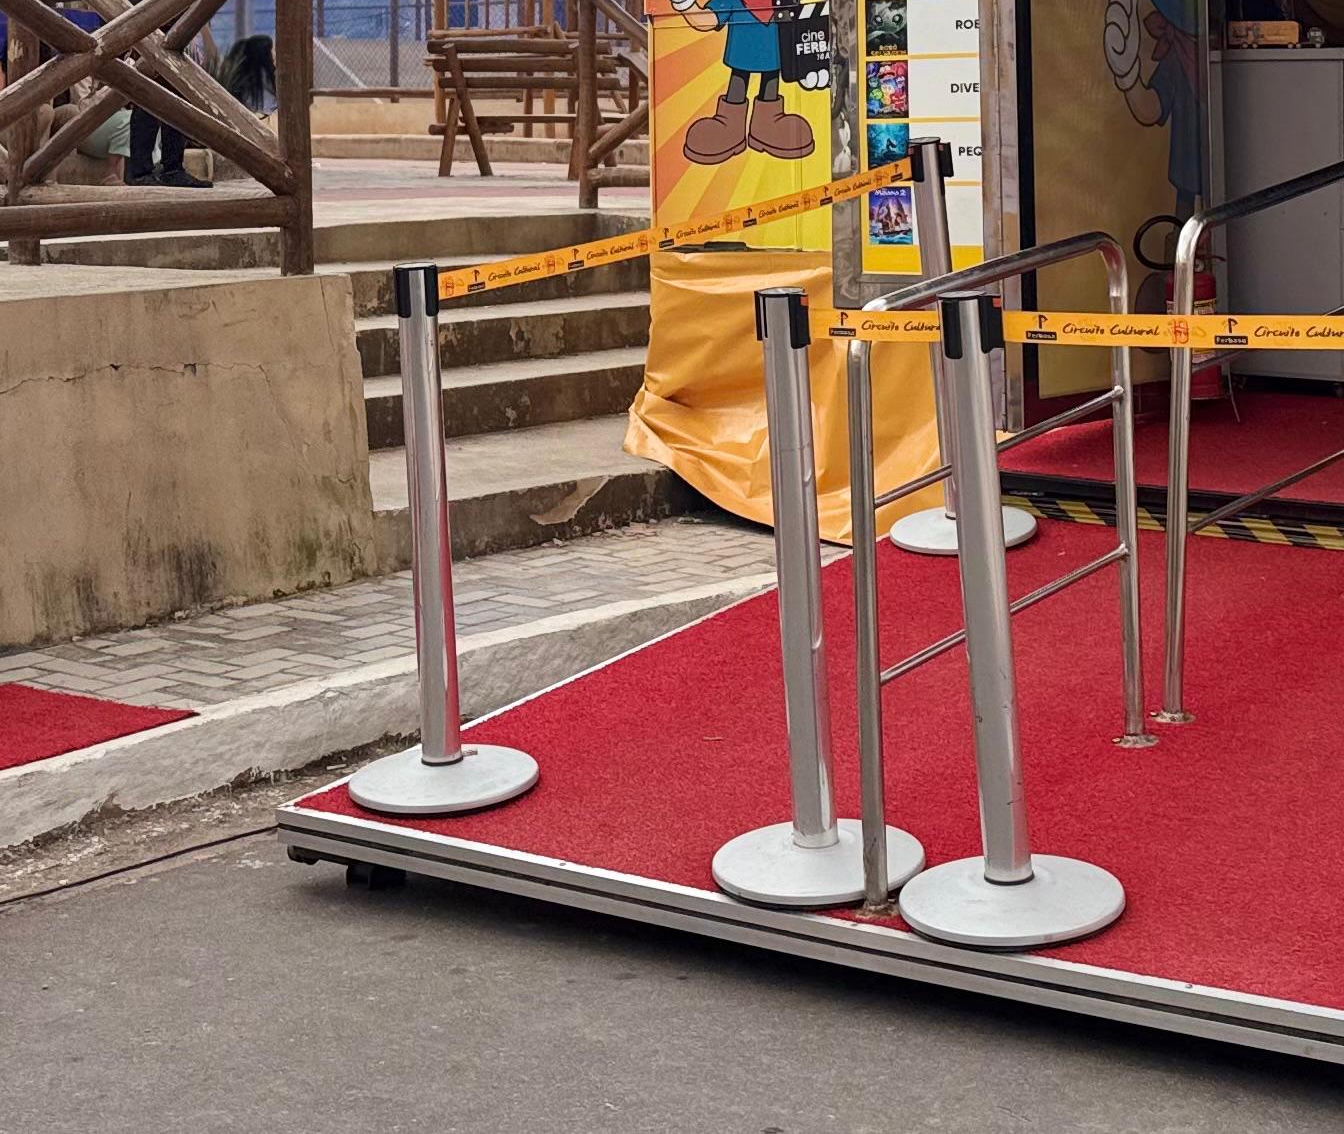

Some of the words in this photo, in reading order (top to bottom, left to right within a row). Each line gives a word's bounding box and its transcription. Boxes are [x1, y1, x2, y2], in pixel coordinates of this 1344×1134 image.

[801, 30, 825, 43] cine
[950, 82, 980, 94] DIVE
[861, 319, 899, 331] Circuito
[1062, 322, 1105, 335] Circuito
[1110, 324, 1159, 336] Cultural
[1254, 325, 1300, 338] Circuito
